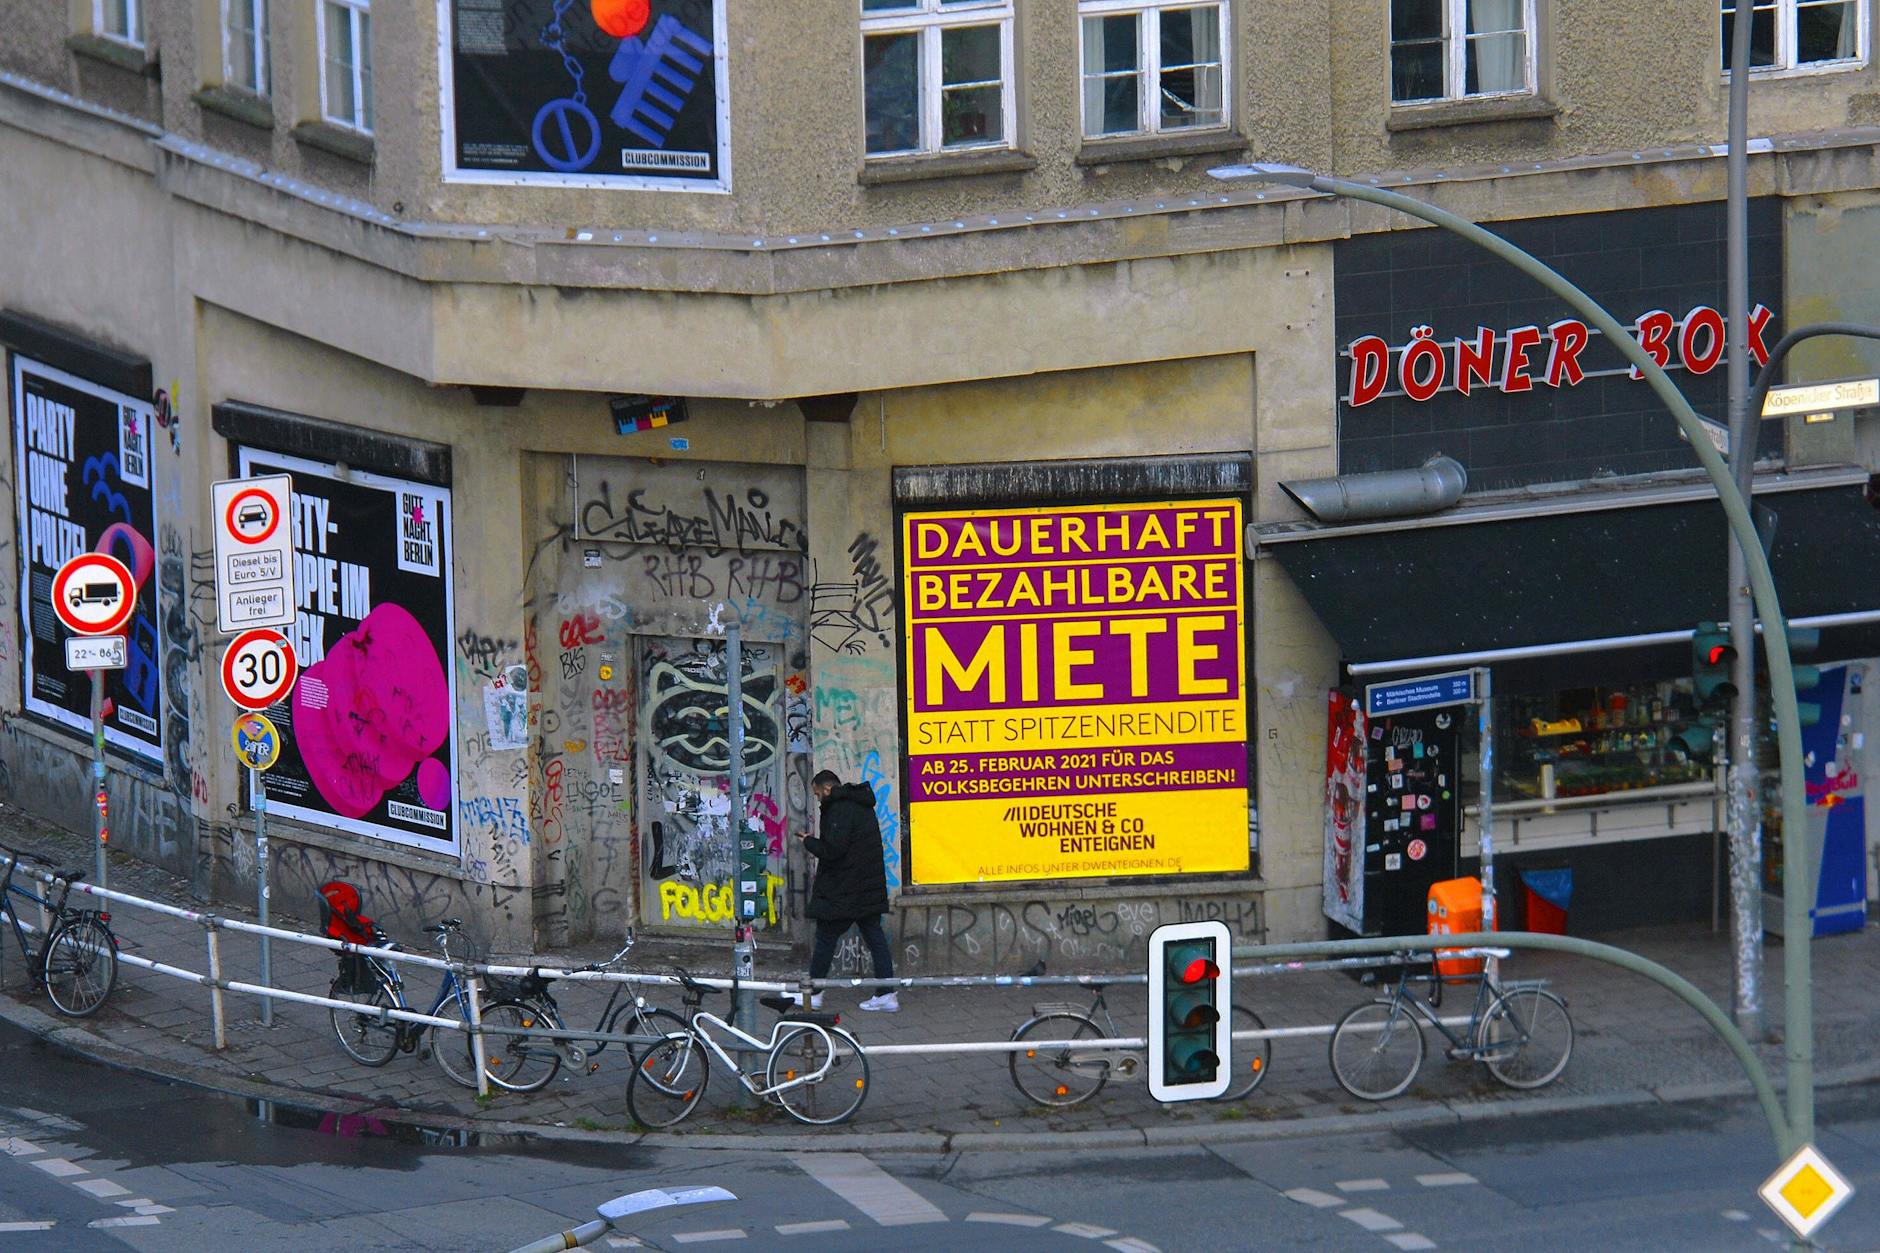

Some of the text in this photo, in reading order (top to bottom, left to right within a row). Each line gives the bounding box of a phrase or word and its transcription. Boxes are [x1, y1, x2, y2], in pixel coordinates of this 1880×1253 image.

[624, 152, 708, 168] CLUBCOMMISSION
[1348, 303, 1773, 407] DÖNER BOX
[26, 391, 76, 463] PARTY
[28, 450, 70, 518] OHNE
[291, 491, 339, 554] RTY-
[917, 511, 1230, 559] DAUERHAFT
[232, 552, 278, 568] Diesel bis
[403, 541, 434, 567] BERLIN
[234, 569, 257, 581] Euro
[293, 551, 371, 621] OPIE IM
[919, 563, 1229, 611] BEZAHLBARE
[235, 592, 278, 607] Anlieger
[248, 603, 267, 616] frei
[239, 649, 280, 688] 30
[924, 615, 1229, 706] MIETE
[918, 709, 1237, 744] STATT SPITZENRENDITE
[921, 749, 1175, 775] AB 25. FEBRUAR 2021 FÜR DAS
[921, 768, 1236, 795] VOLKSBEGEHREN UNTERSCHREIBEN!
[389, 804, 446, 827] CLUBCOMMISSION
[1020, 817, 1144, 838] WOHNEN & CO
[1060, 834, 1155, 853] ENTEIGNEN
[978, 865, 1004, 876] ALLE
[1006, 863, 1040, 874] INFOS
